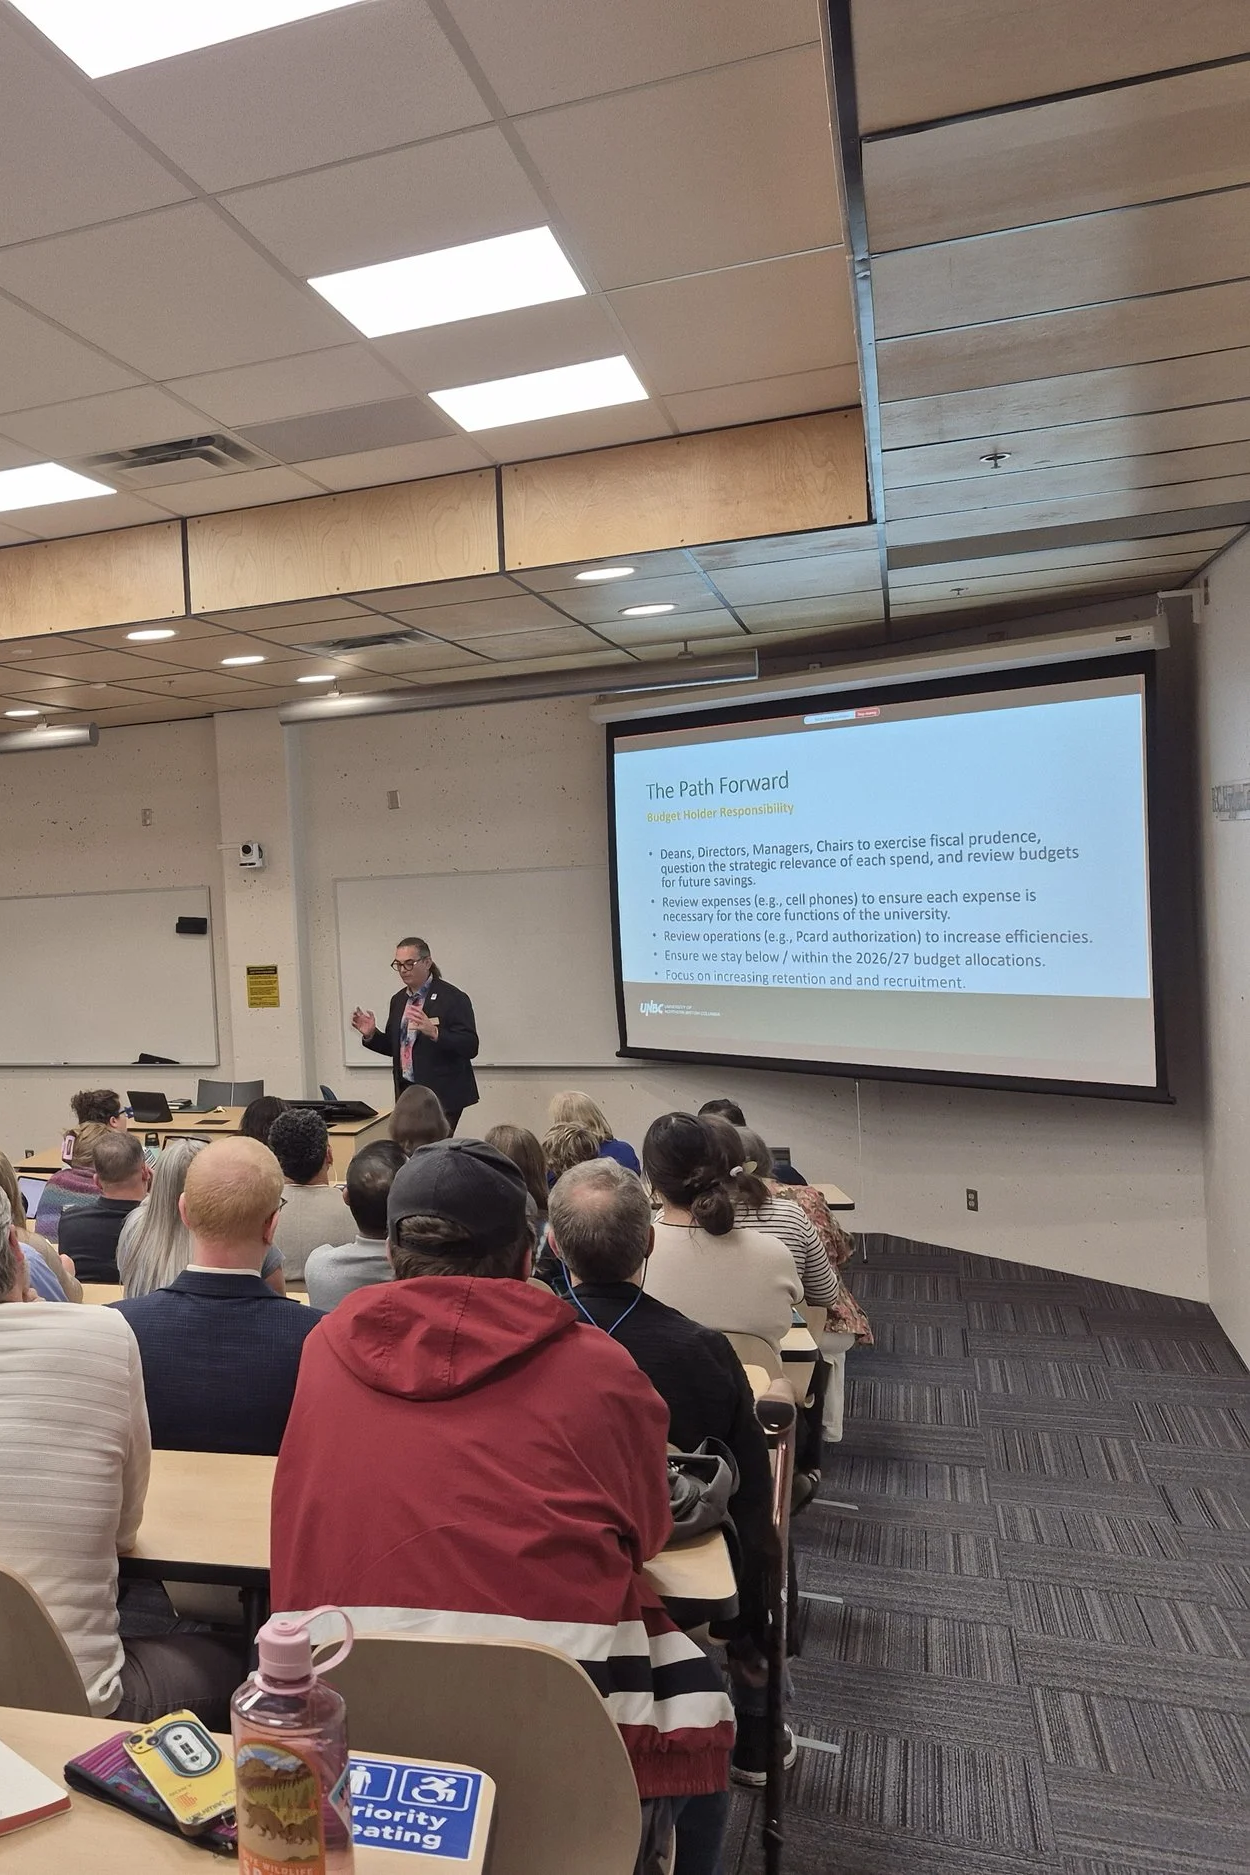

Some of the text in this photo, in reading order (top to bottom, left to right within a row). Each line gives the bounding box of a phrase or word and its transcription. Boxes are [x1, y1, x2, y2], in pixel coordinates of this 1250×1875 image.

[646, 770, 789, 800] The Path Forward
[647, 803, 794, 823] Budget Holder Responsibility
[660, 830, 1041, 860] Deans, Directors, Managers, Chairs to exercise fiscal prudence,
[661, 846, 1079, 875] question the strategic relevance of each spend, and review budgets
[661, 875, 756, 888] for future savings.
[662, 889, 1037, 909] Review expenses (e.g., cell phones) to ensure each expense is
[663, 907, 951, 924] necessary for the core functions of the university.
[664, 929, 1093, 945] Review operations (e.g., Pcard authorization) to increase efficiencies.
[665, 950, 1046, 968] Ensure we stay below / within the 2026/27 budget allocations.
[665, 970, 966, 989] Focus on increasing retention and and recruitment.
[640, 1000, 664, 1016] UNBC
[352, 1803, 448, 1831] riority
[352, 1823, 442, 1850] eating
